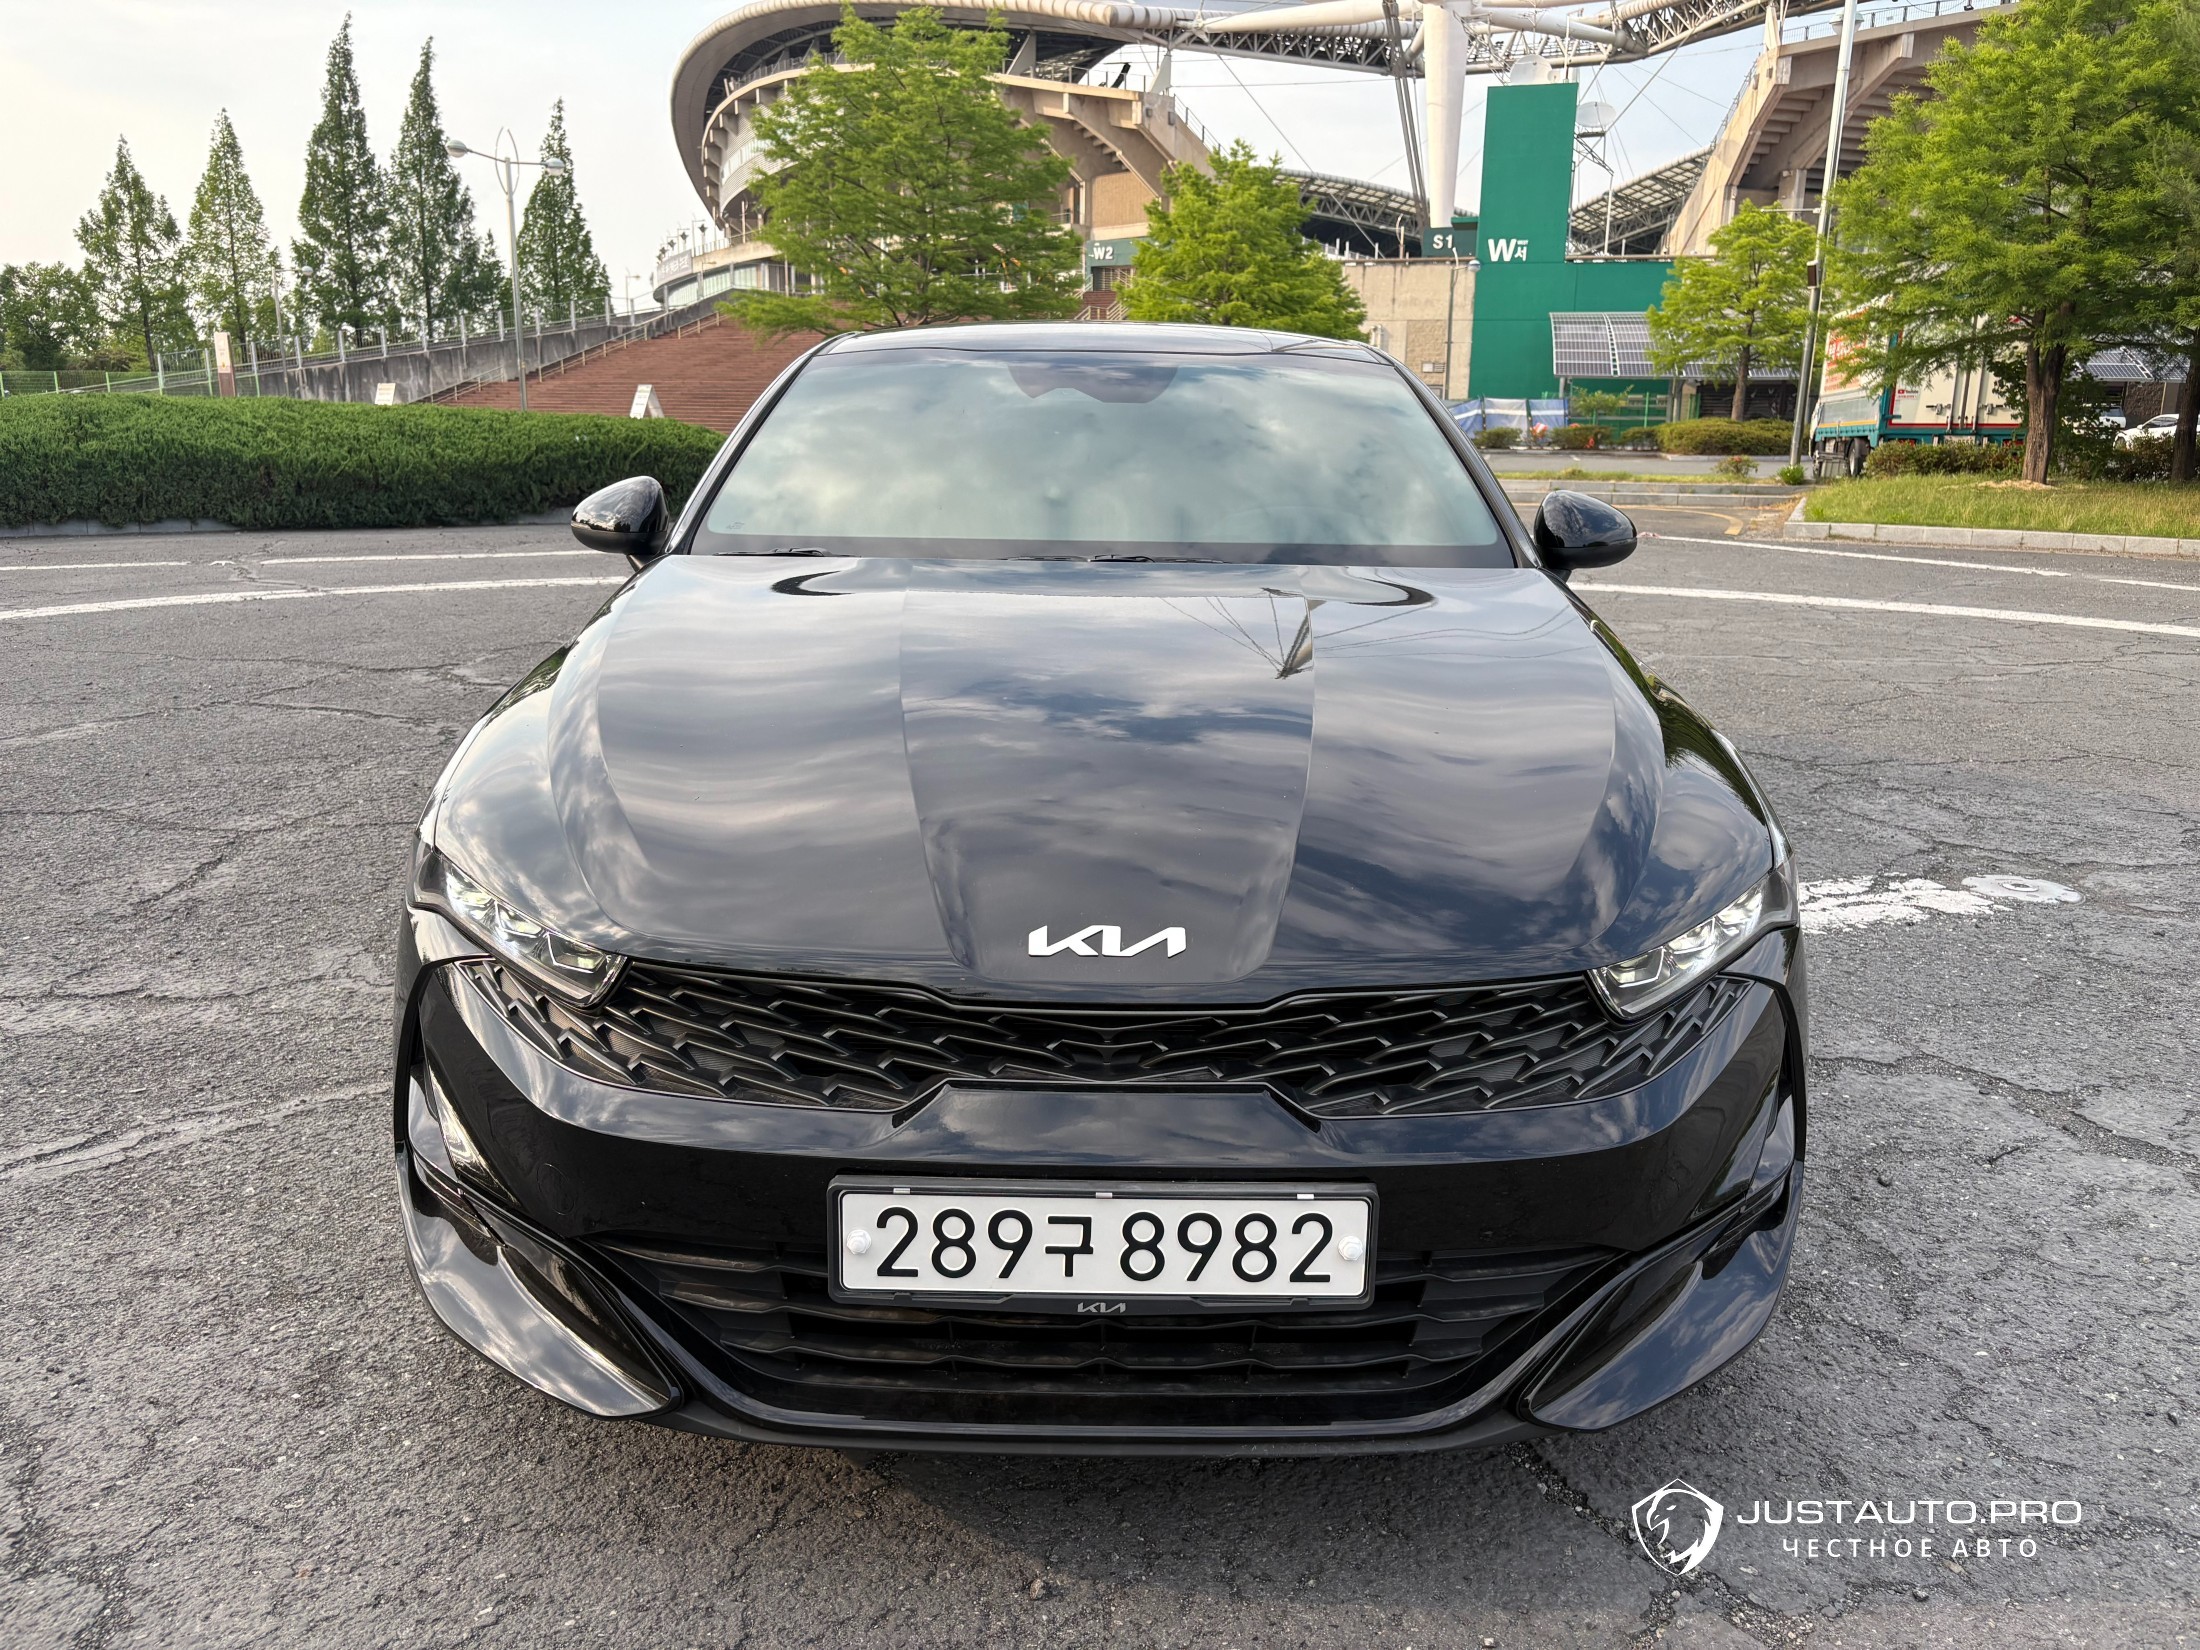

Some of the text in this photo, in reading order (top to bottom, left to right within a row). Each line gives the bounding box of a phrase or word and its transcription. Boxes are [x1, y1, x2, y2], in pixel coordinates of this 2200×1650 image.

[1432, 234, 1453, 249] S1
[1487, 238, 1517, 262] W
[1093, 246, 1113, 260] W2
[1028, 924, 1187, 958] KIA
[876, 1206, 1333, 1283] 289구 8982
[1077, 1302, 1126, 1313] KIA
